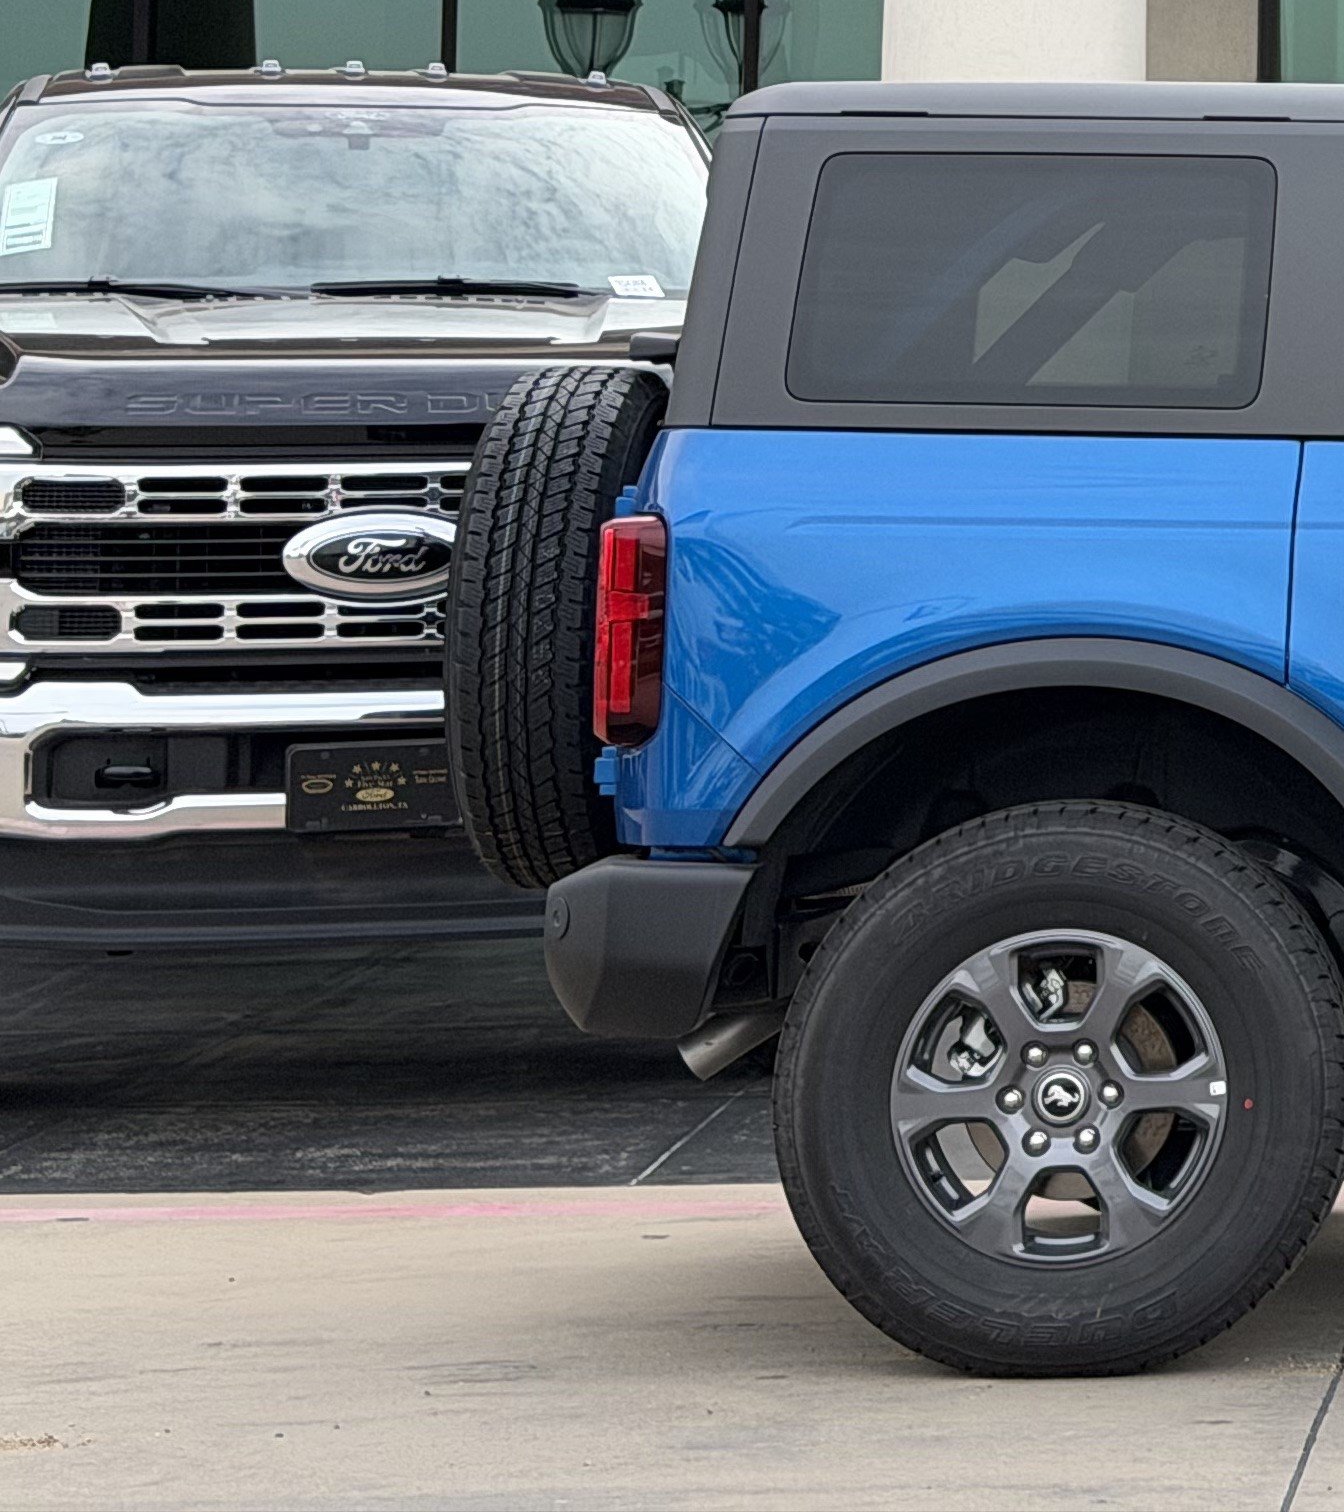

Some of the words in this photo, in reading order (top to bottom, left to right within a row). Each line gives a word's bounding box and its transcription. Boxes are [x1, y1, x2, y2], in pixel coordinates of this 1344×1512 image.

[126, 392, 408, 416] SUPER
[338, 537, 429, 574] Ford
[886, 852, 1268, 976] BRIDGESTONE
[880, 1263, 1187, 1349] DUELER
